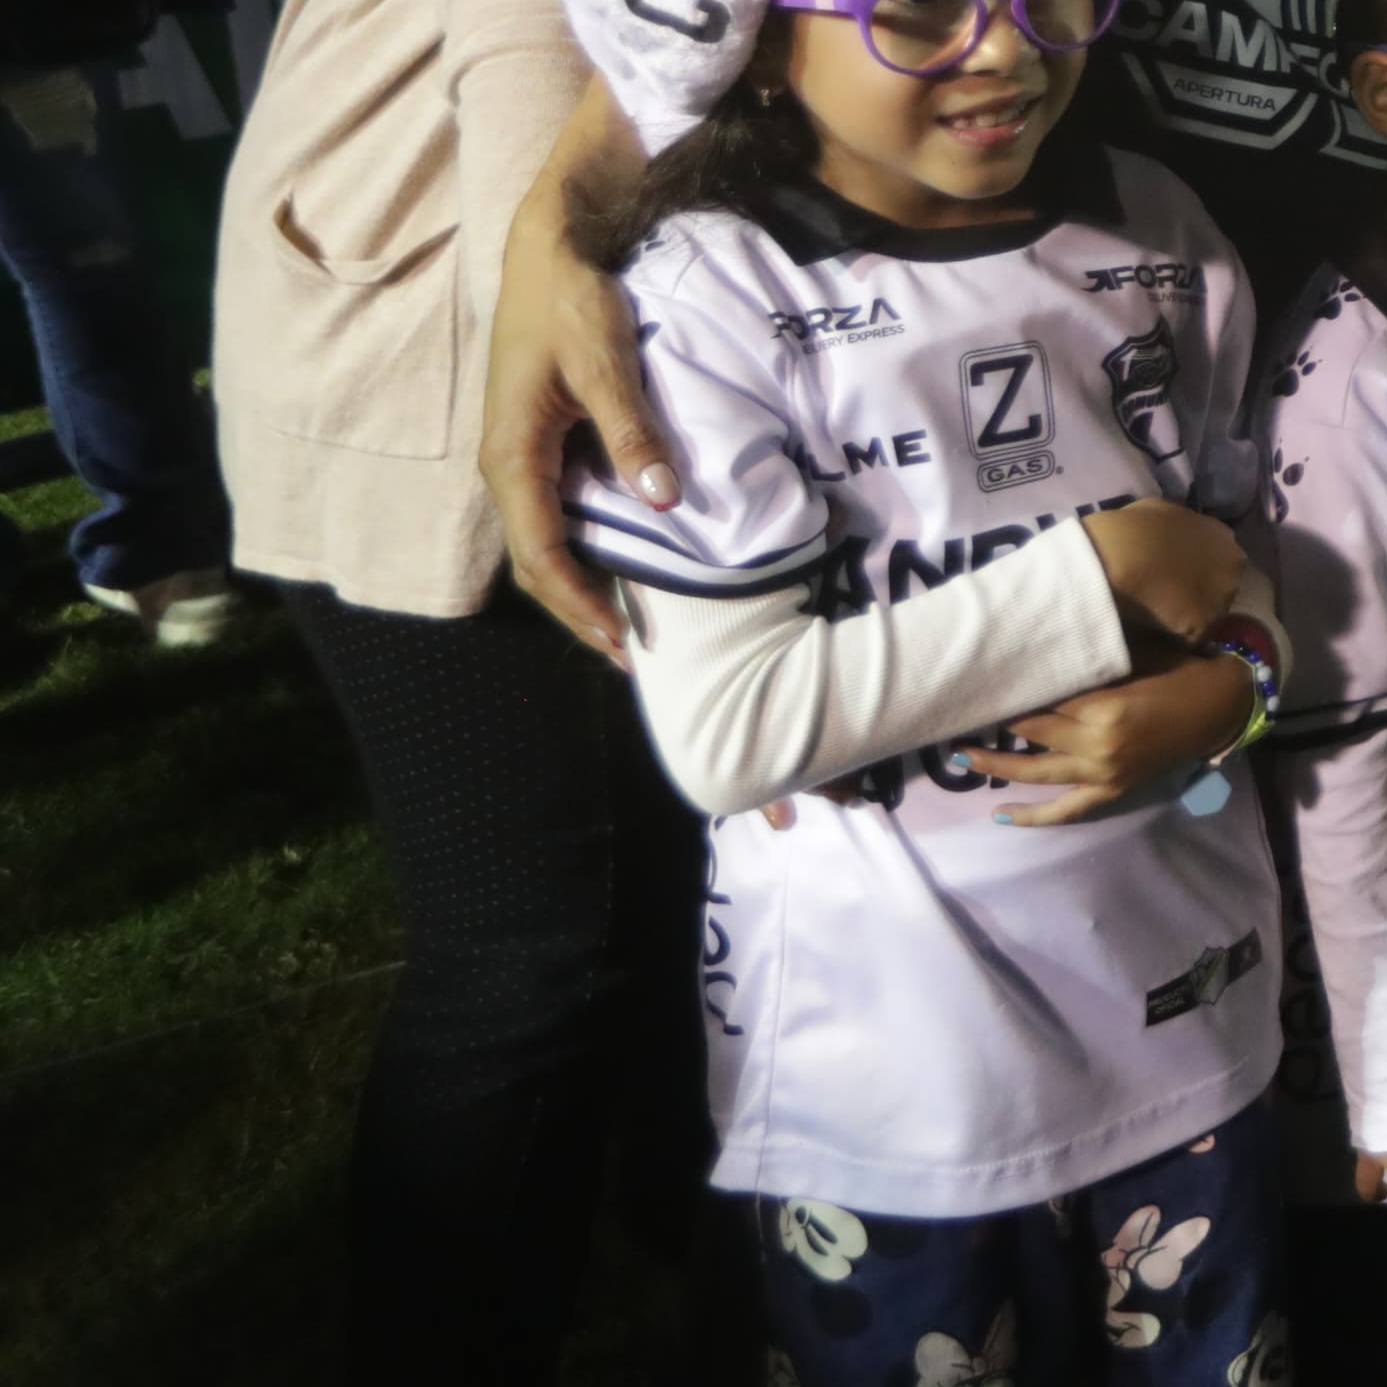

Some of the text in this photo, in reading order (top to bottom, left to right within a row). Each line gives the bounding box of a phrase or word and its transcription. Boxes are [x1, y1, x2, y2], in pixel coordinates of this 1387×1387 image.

[1173, 75, 1278, 113] APERTURA
[846, 324, 906, 345] EXPRESS
[969, 352, 1044, 449] Z
[806, 429, 932, 482] LME
[986, 458, 1044, 484] GAS
